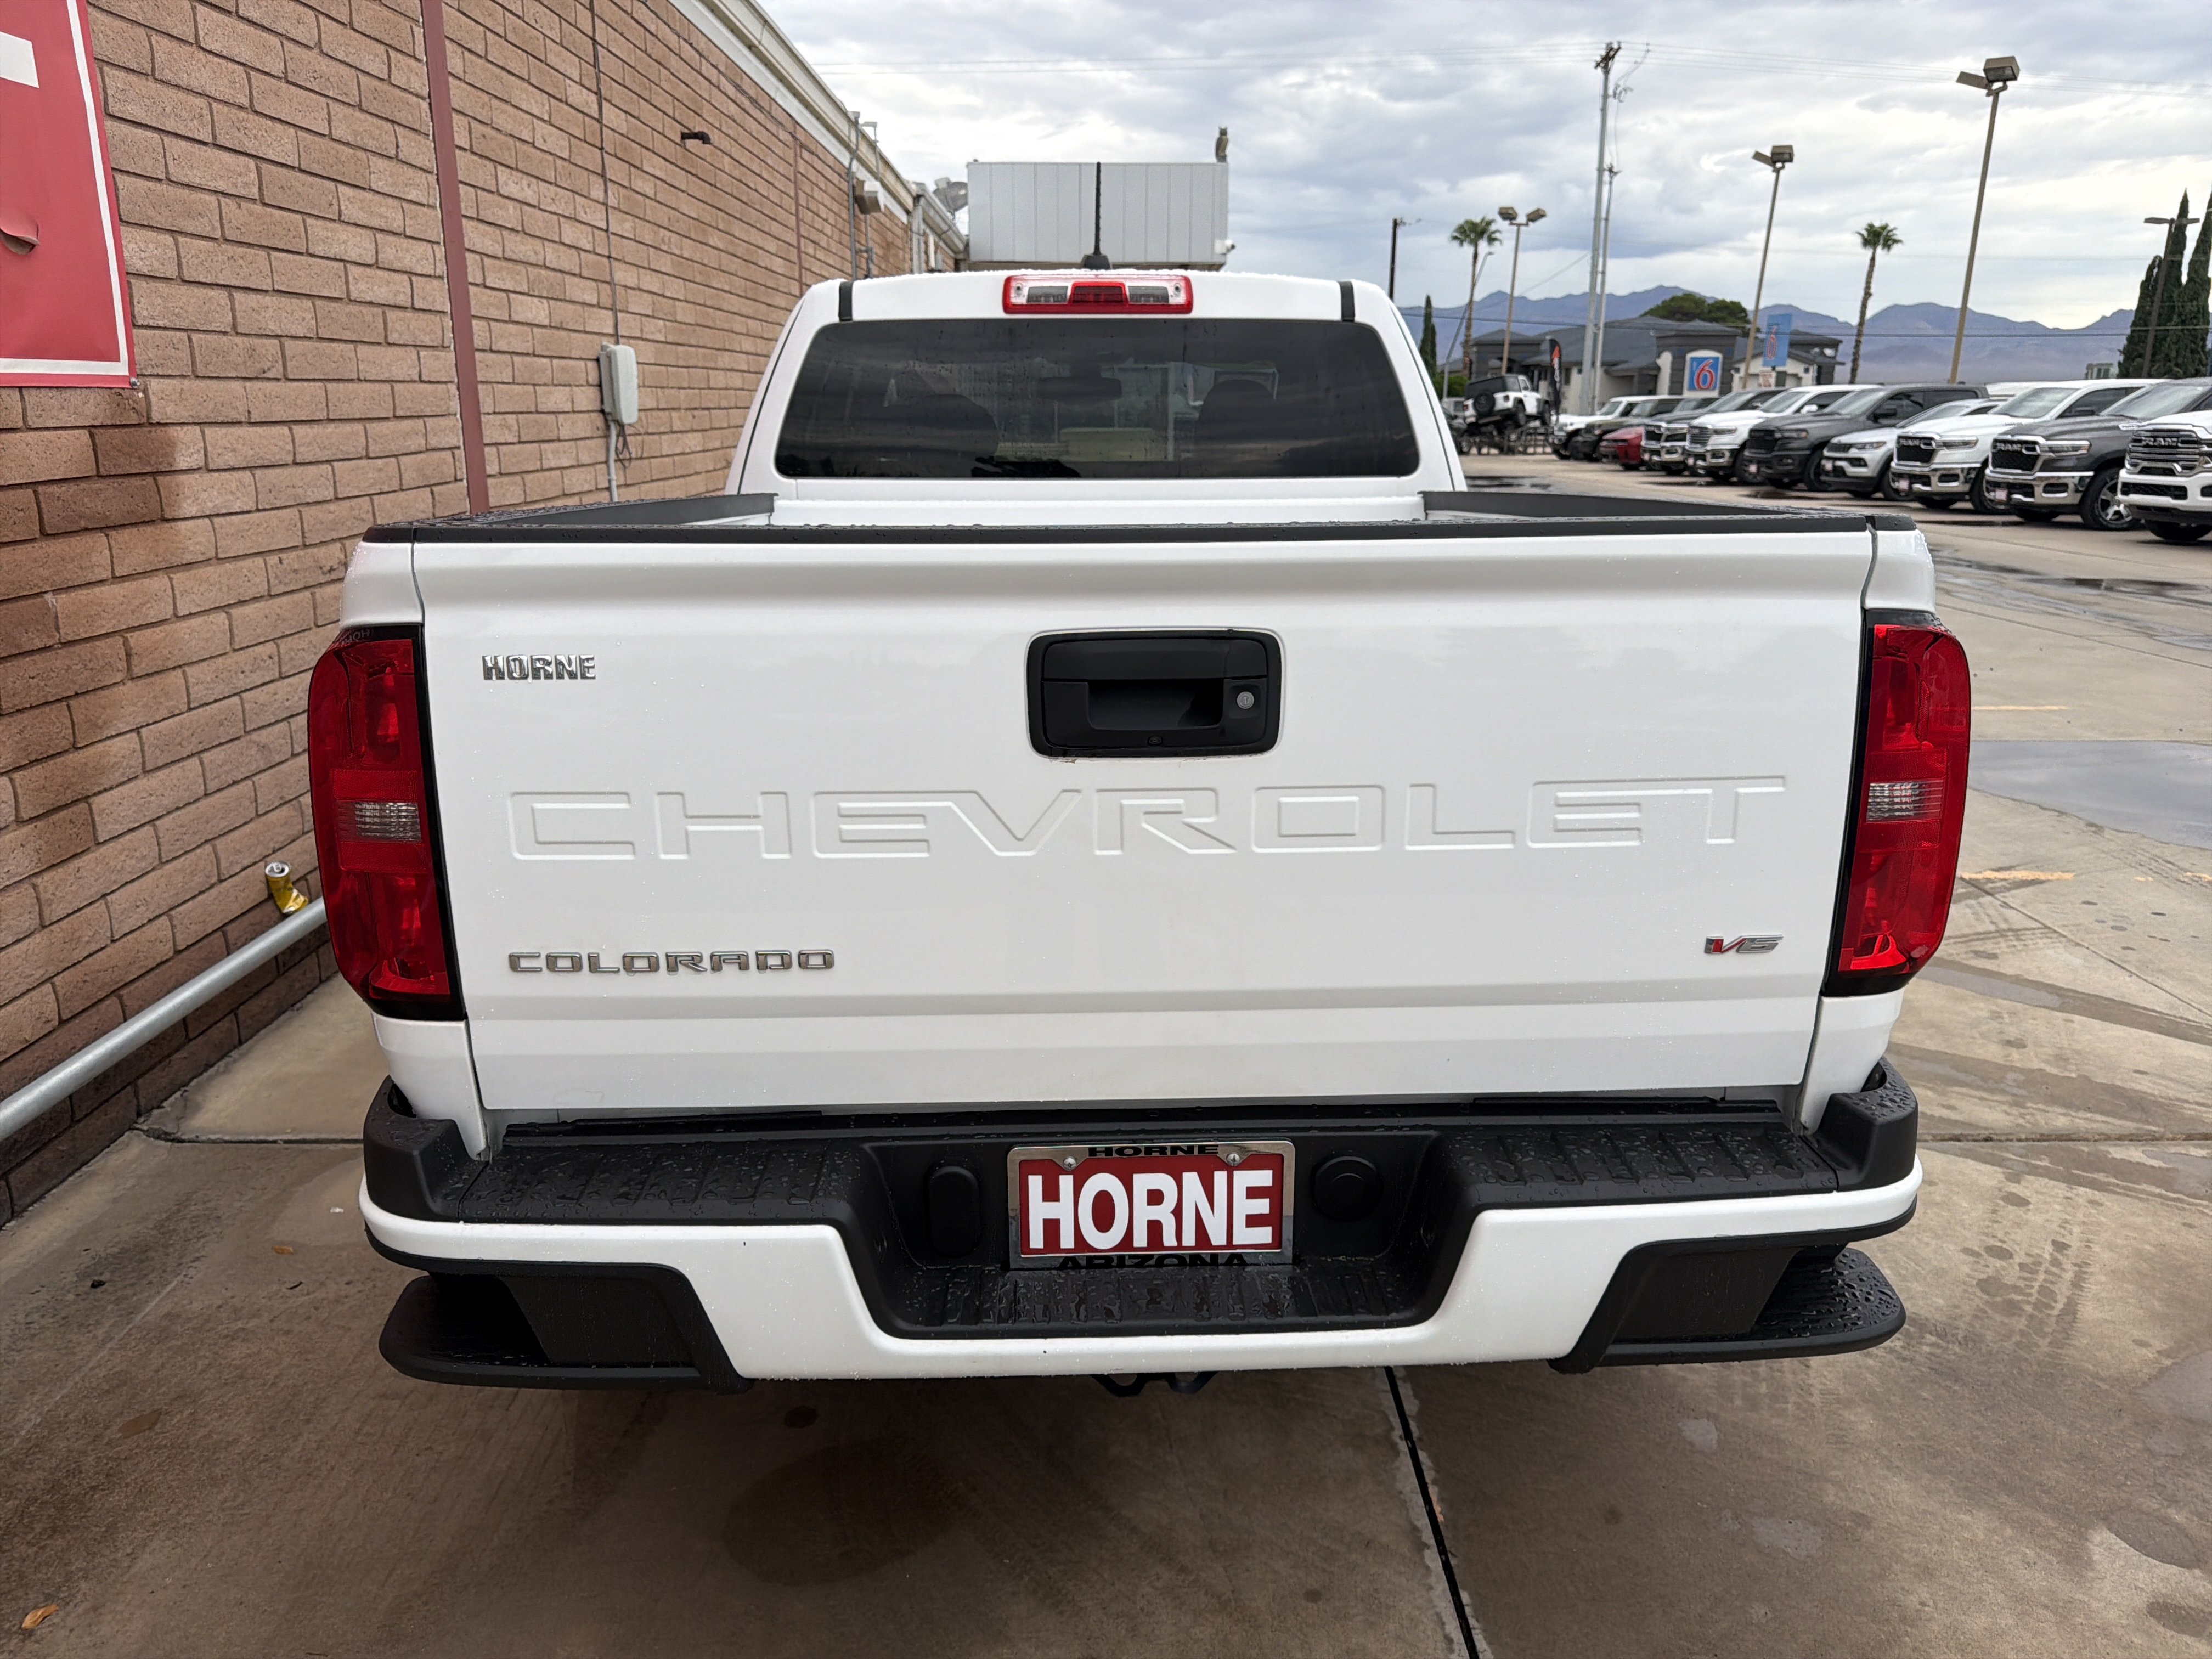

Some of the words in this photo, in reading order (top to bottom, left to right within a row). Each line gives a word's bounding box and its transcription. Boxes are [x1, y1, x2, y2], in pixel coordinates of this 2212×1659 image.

[1694, 359, 1716, 391] 6
[2142, 437, 2177, 446] RAM
[481, 654, 596, 681] HORNE
[508, 775, 1786, 860] CHEVROLET
[1704, 934, 1784, 954] V6
[508, 949, 836, 975] COLORADO
[1088, 1144, 1219, 1157] HORNE
[1028, 1170, 1273, 1250] HORNE
[1058, 1253, 1248, 1269] ARIZONA
